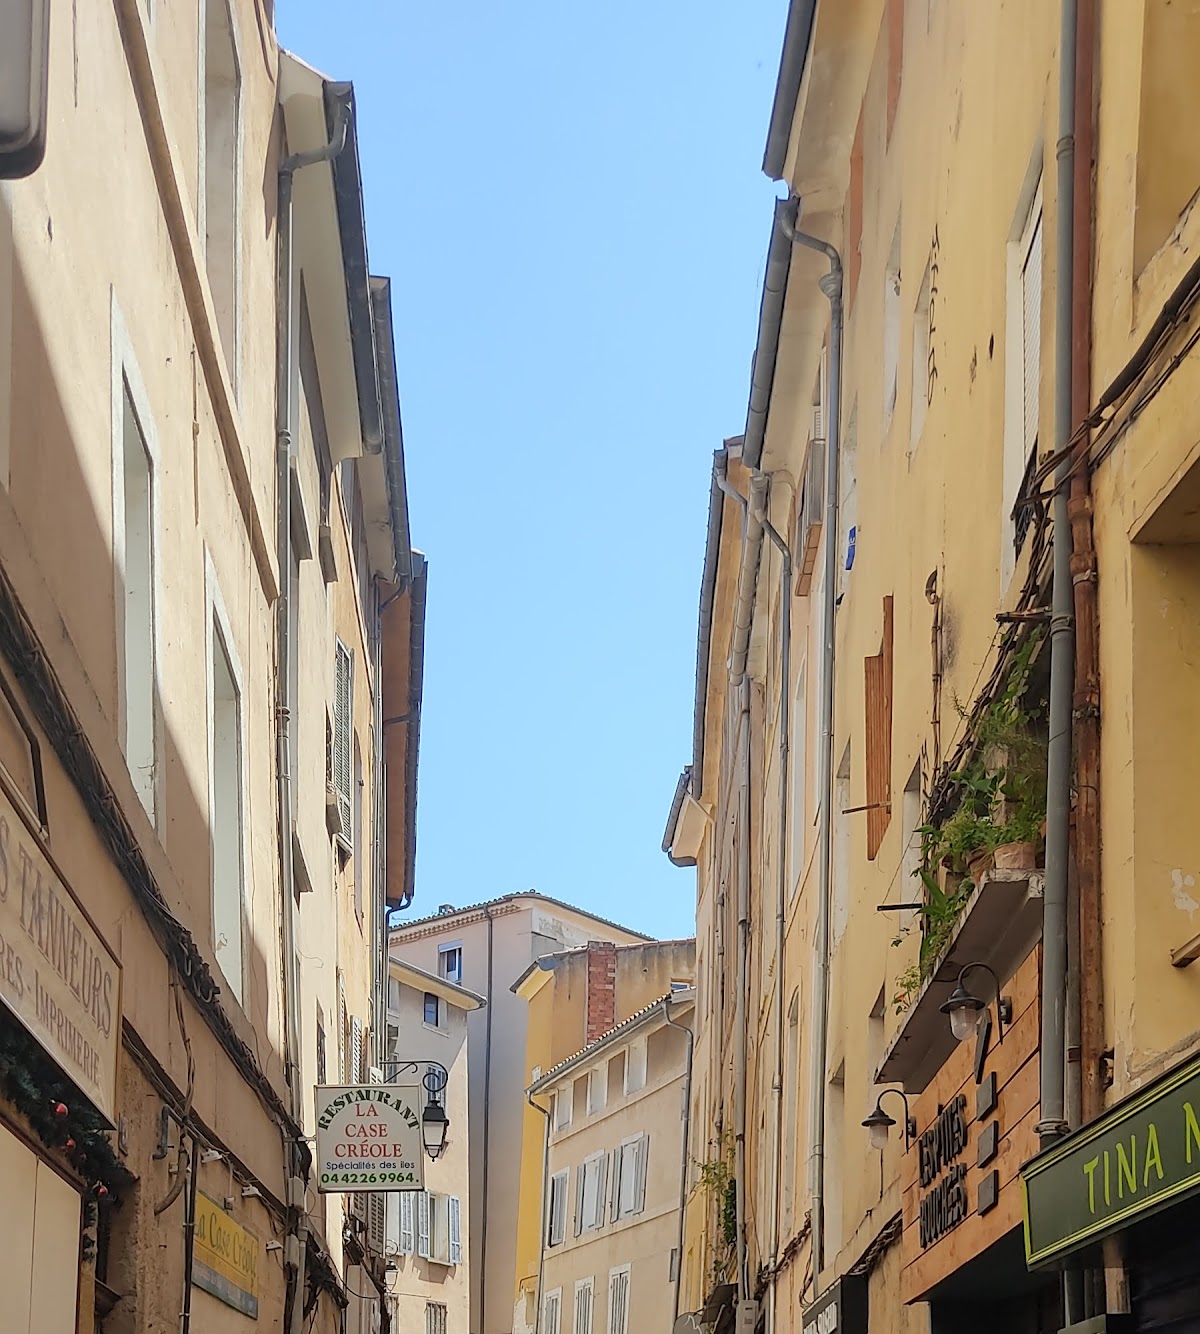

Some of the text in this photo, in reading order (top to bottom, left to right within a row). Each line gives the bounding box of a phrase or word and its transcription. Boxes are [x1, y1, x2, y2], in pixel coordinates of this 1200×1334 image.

[19, 841, 112, 1037] TANNEURS
[35, 968, 101, 1087] IMPRIMERIE
[318, 1089, 420, 1131] RESTAURANT
[345, 1123, 388, 1138] CASE
[355, 1103, 379, 1117] LA
[334, 1139, 403, 1158] CRÉOLE
[379, 1160, 397, 1169] des
[1083, 1123, 1164, 1214] TINA
[209, 1212, 231, 1258] Case
